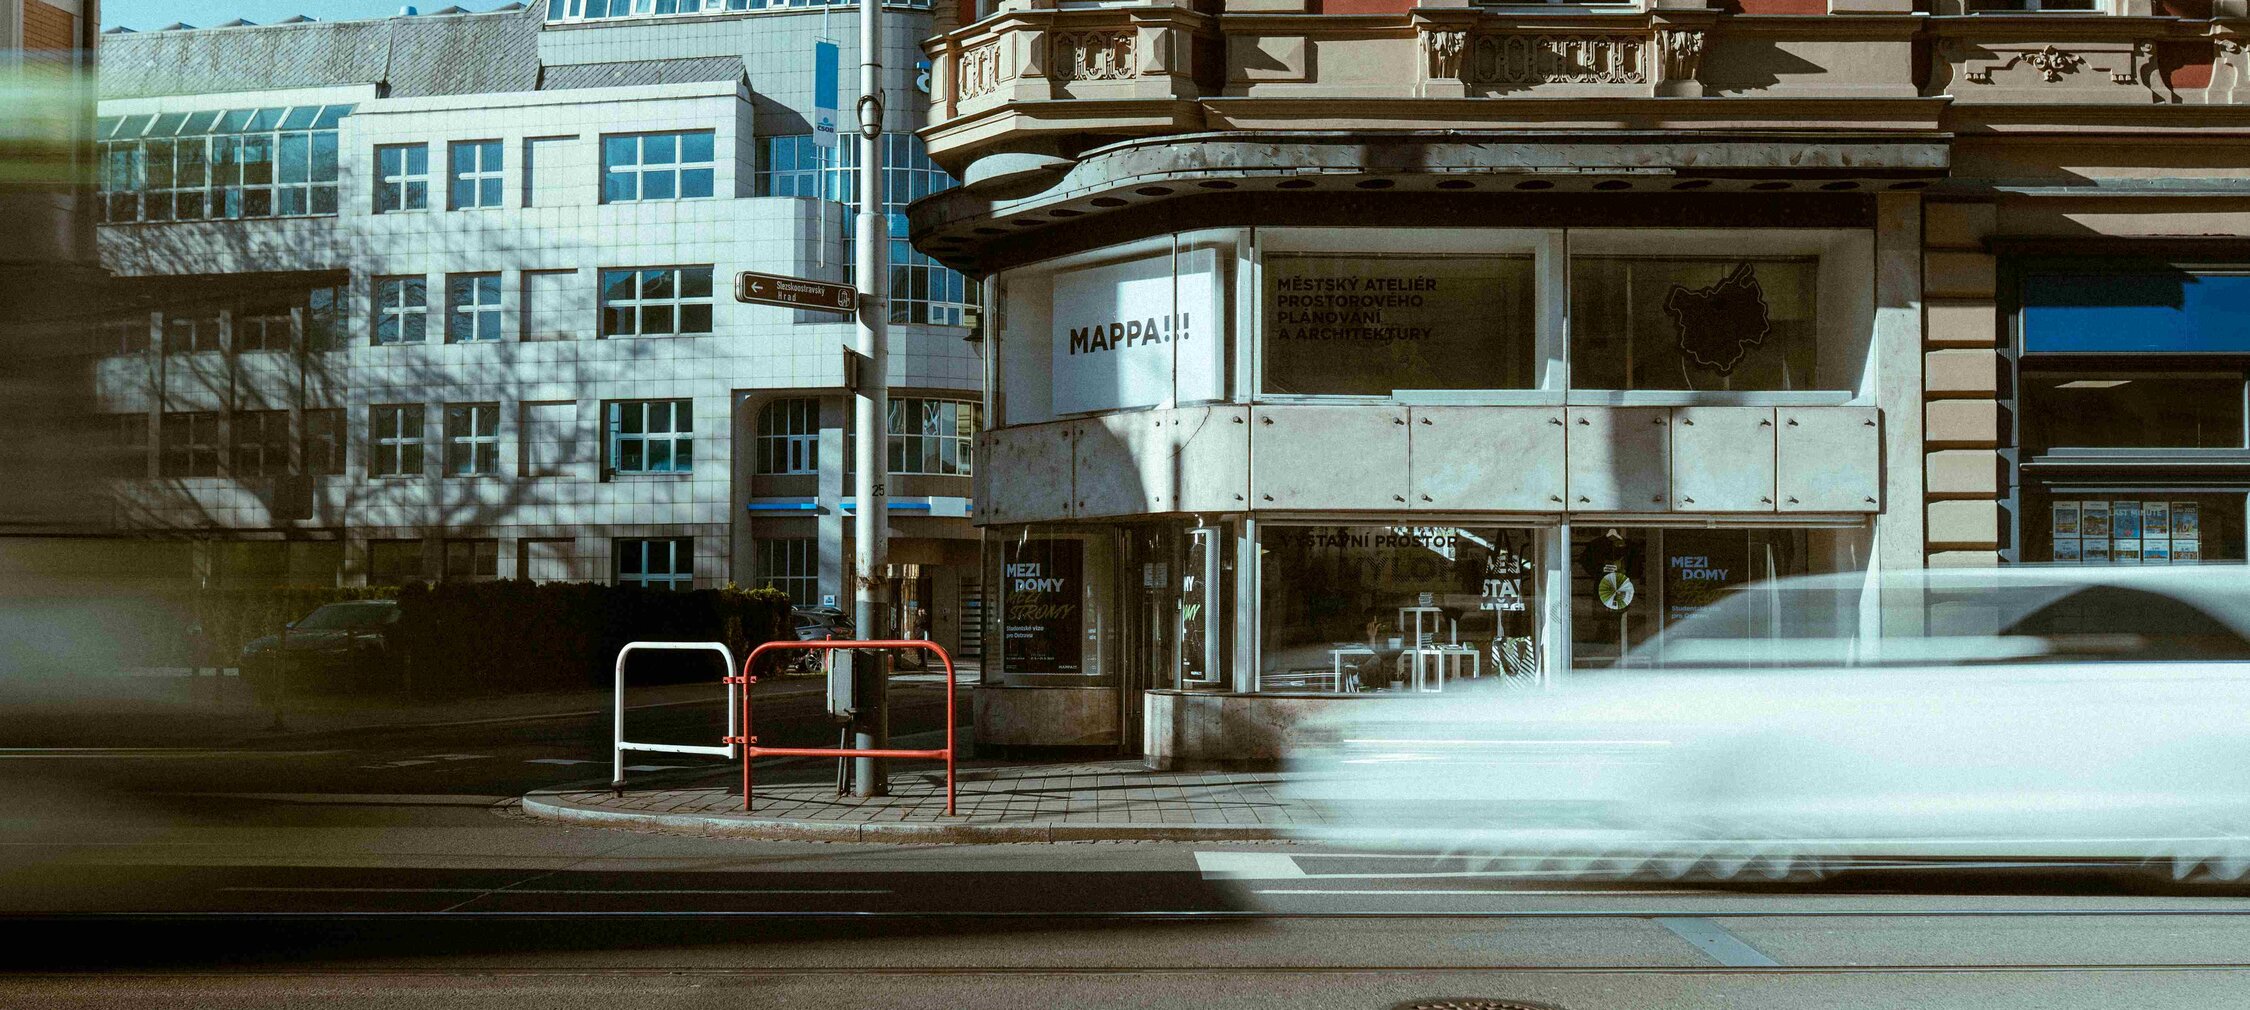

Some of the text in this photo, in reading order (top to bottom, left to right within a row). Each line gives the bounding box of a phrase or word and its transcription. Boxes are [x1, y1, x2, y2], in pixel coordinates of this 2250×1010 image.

[776, 280, 825, 296] Slezskoostravský
[1277, 276, 1437, 291] MĚSTSKÝ ATELIÉR
[777, 291, 797, 302] Hrad
[1277, 292, 1424, 307] PROSTOROVÉHO
[1278, 328, 1432, 340] A ARCHITEKTURY
[872, 484, 885, 496] 25
[2109, 508, 2128, 516] LAST
[1375, 534, 1458, 548] PROSTOR
[1671, 556, 1708, 568] MEZI
[1006, 563, 1041, 577] MEZI
[1682, 569, 1729, 581] DOMY
[1015, 578, 1065, 593] DOMY
